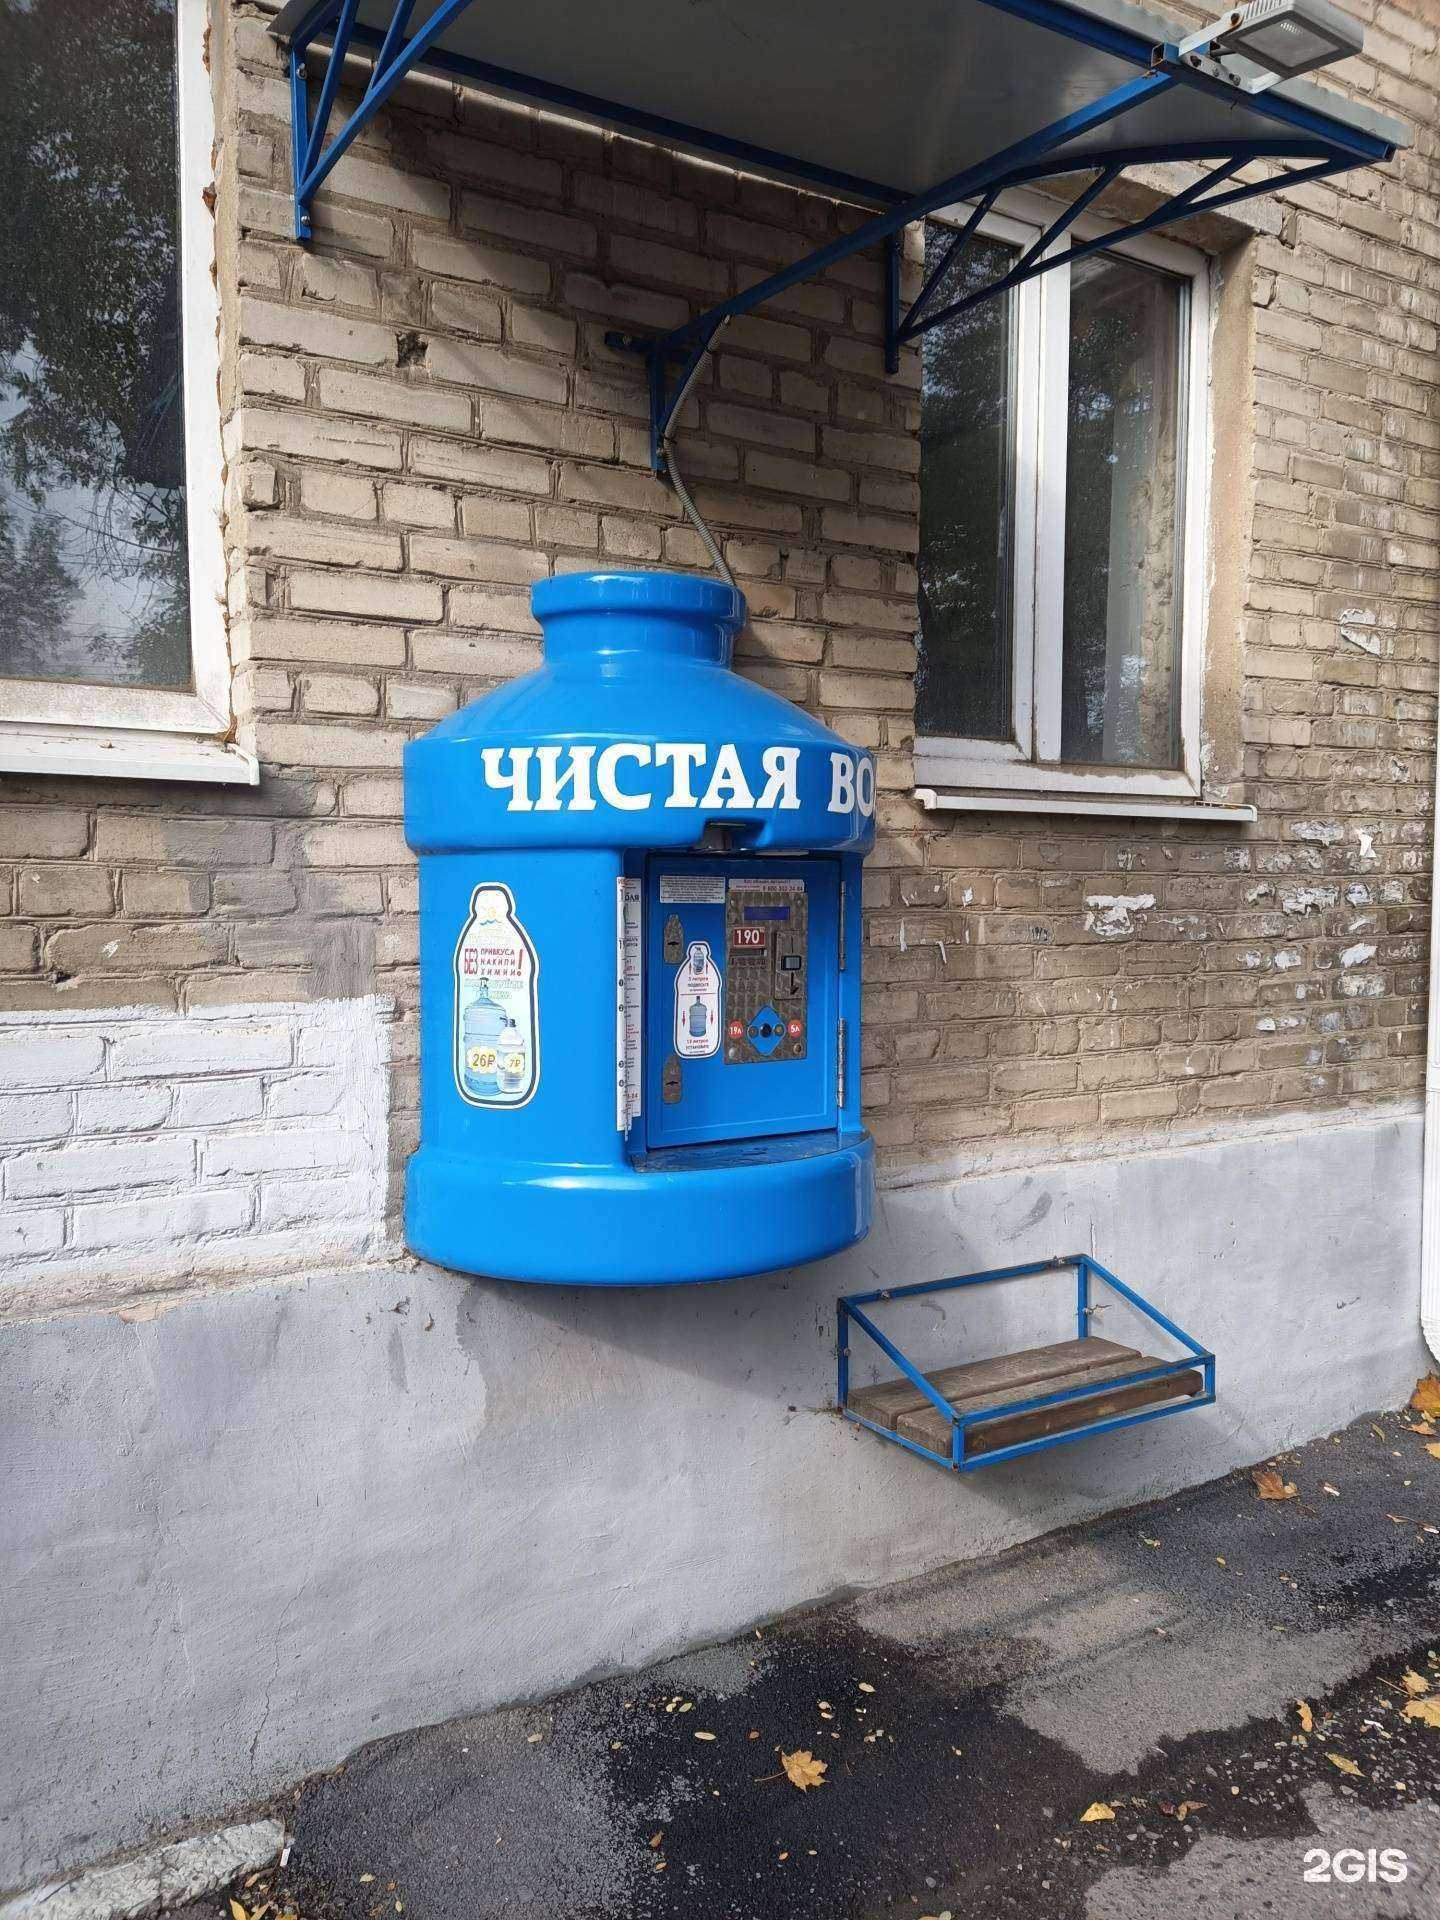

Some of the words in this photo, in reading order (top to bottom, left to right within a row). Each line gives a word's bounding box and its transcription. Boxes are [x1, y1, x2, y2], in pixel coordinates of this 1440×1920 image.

[480, 743, 801, 811] ЧИСТАЯ
[827, 752, 874, 817] ВО
[736, 929, 760, 944] 190
[464, 948, 479, 975] БЕЗ
[480, 948, 515, 956] ПРИВКУСА
[480, 958, 516, 967] НАКИПИ
